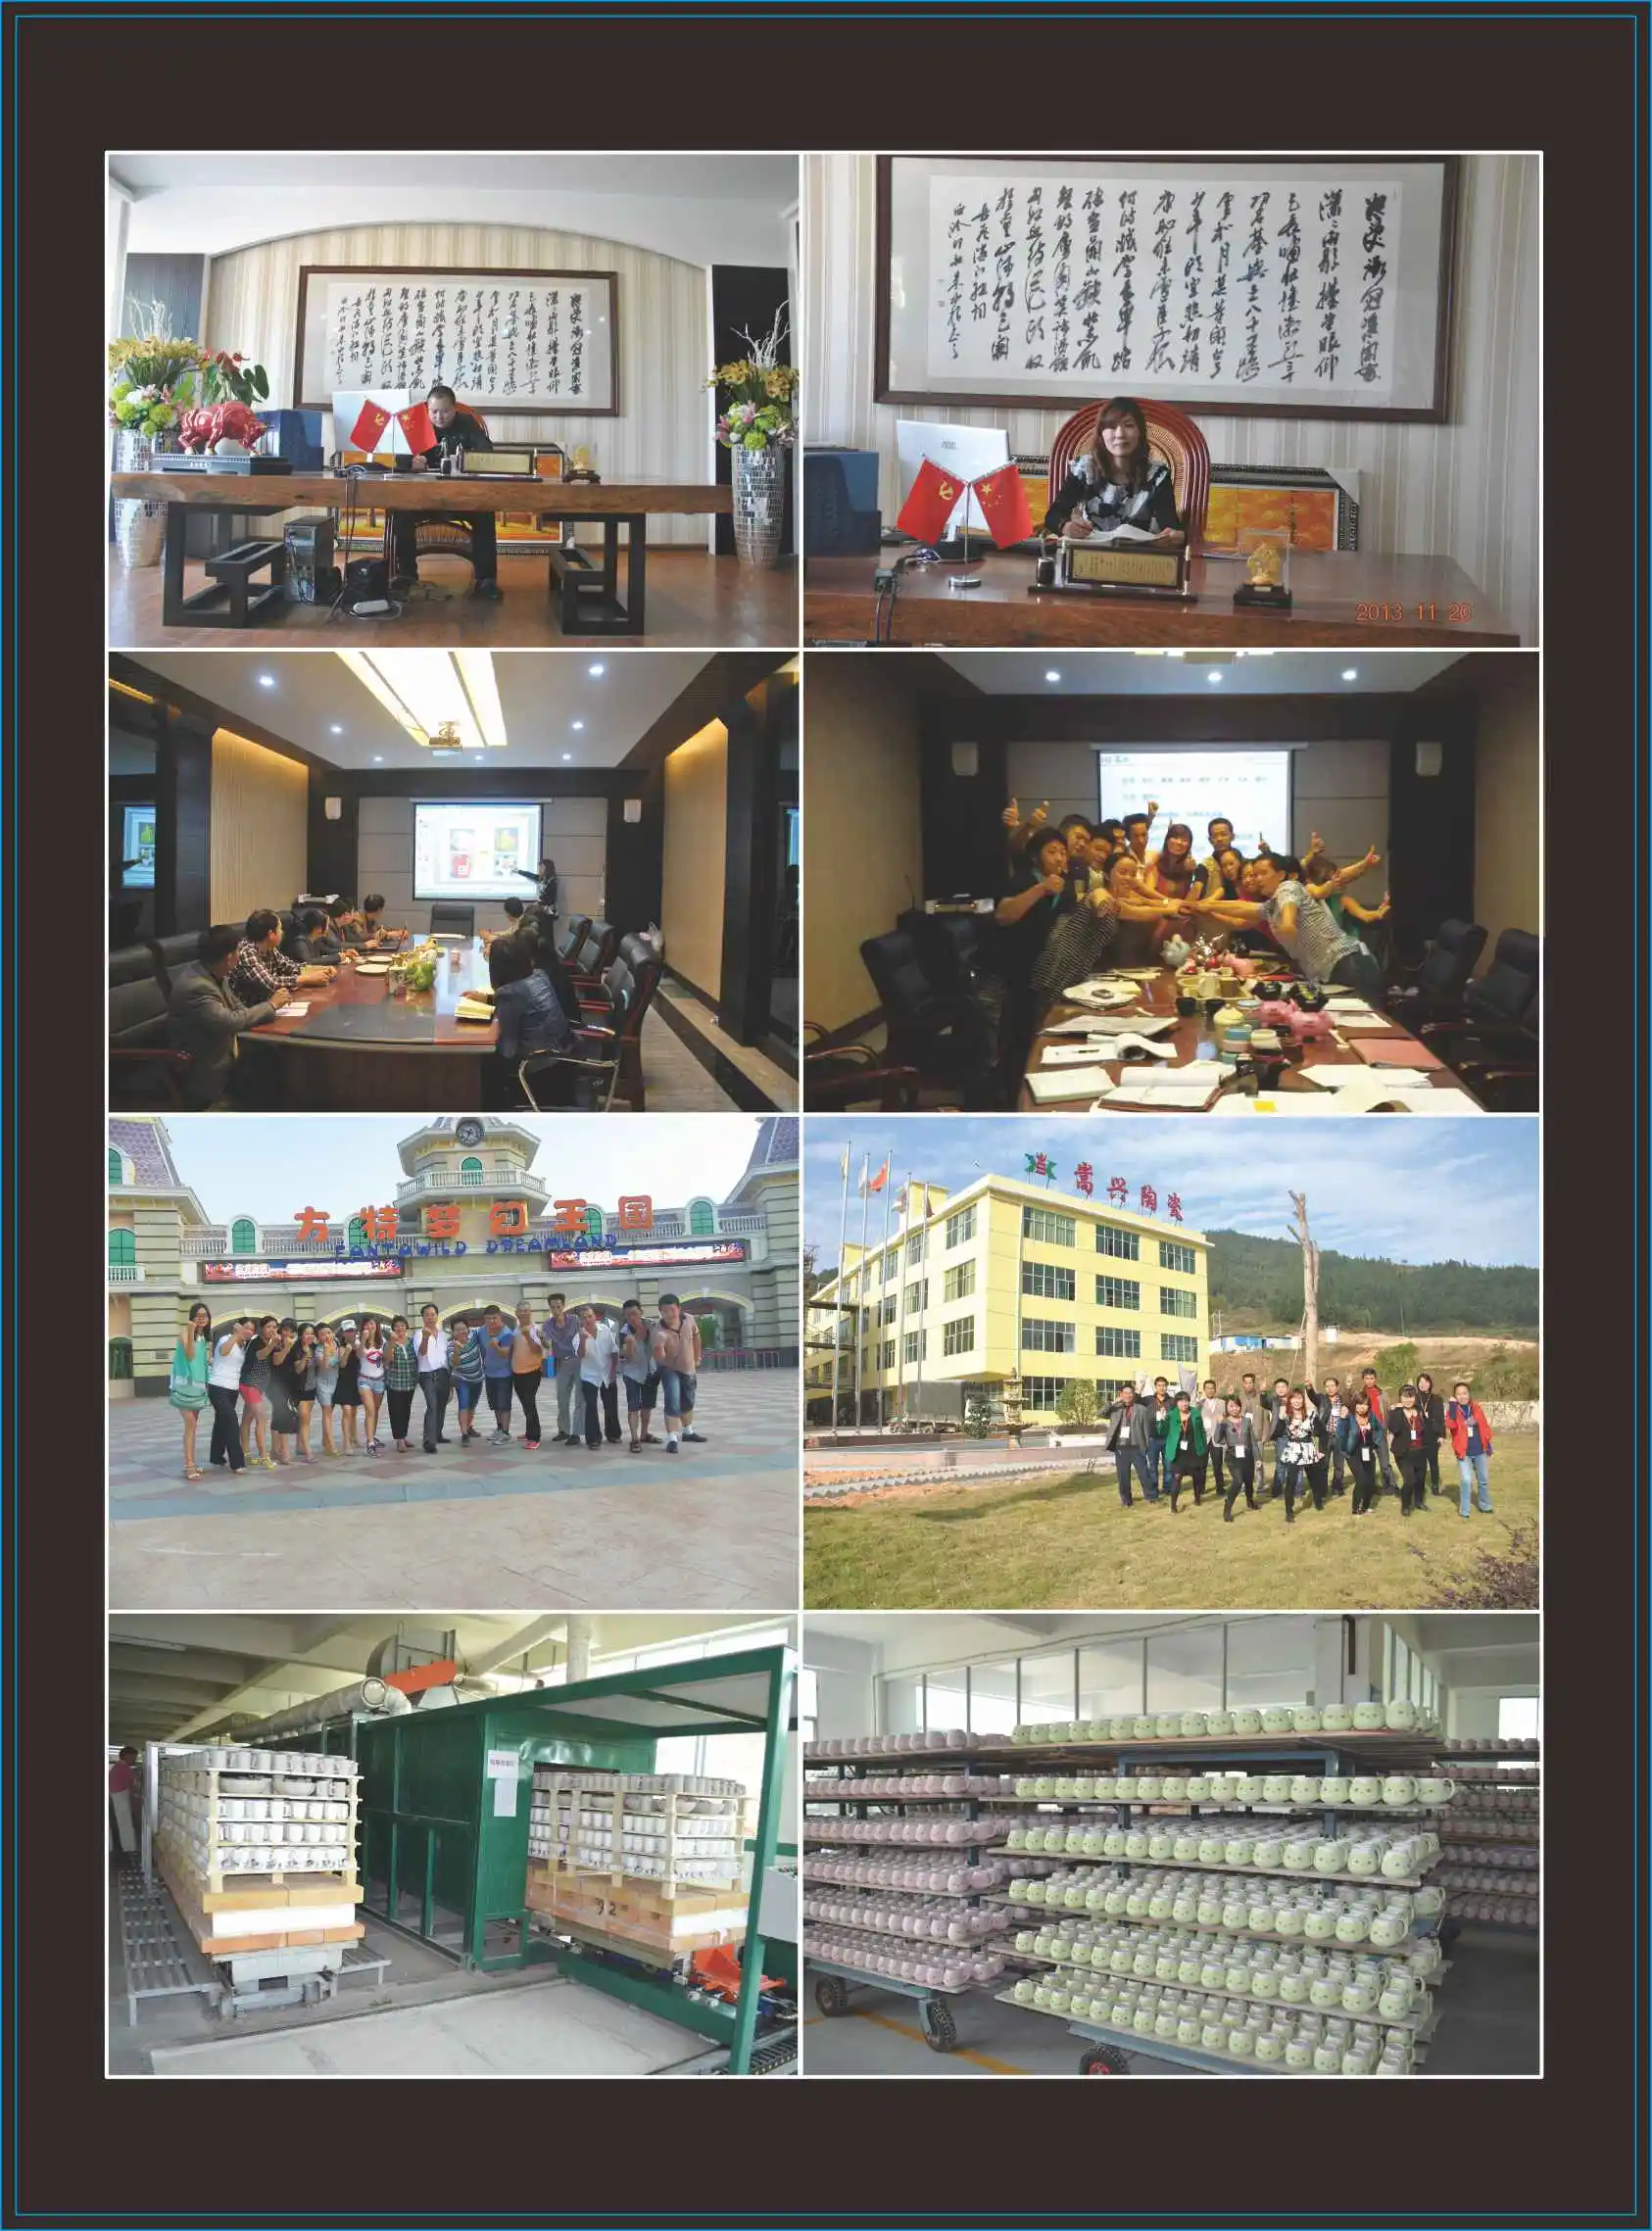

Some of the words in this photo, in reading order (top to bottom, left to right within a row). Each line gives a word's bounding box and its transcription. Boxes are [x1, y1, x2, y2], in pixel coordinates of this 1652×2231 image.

[1074, 1162, 1184, 1222] 嵩兴陶瓷
[294, 1195, 654, 1243] 方特梦幻王国
[335, 1238, 467, 1258] FANTAWILD
[485, 1233, 618, 1254] DREAMLAND
